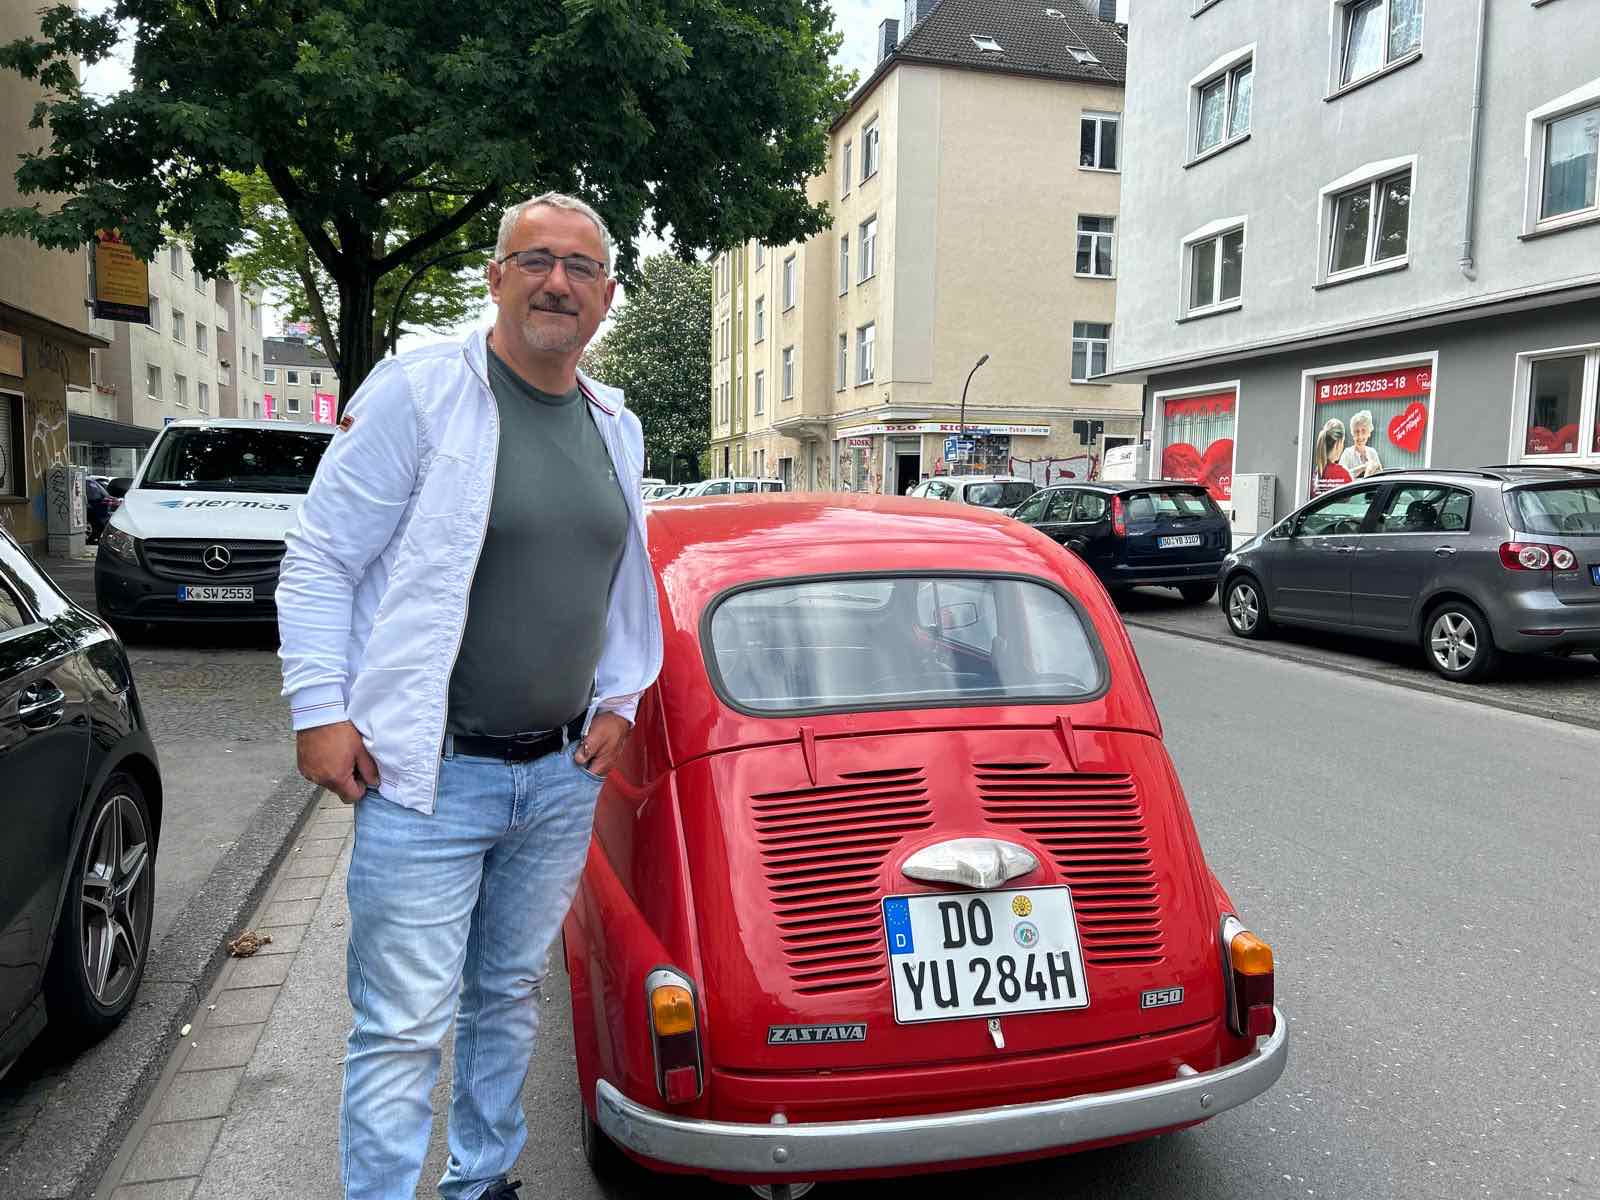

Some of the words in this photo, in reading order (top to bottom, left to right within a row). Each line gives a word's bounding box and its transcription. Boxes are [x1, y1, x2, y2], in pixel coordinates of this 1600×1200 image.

[1332, 383, 1352, 396] 0231
[1355, 376, 1407, 393] 225253-18
[848, 439, 871, 447] KIOSK
[184, 499, 292, 511] Hermes
[186, 587, 194, 599] K
[203, 587, 219, 600] SW
[221, 587, 252, 600] 2553
[938, 898, 994, 949] DO
[896, 933, 907, 948] D
[902, 959, 960, 1011] YU
[968, 951, 1077, 1006] 284H
[1145, 989, 1181, 1006] 850
[771, 1026, 864, 1041] ZASTAVA
